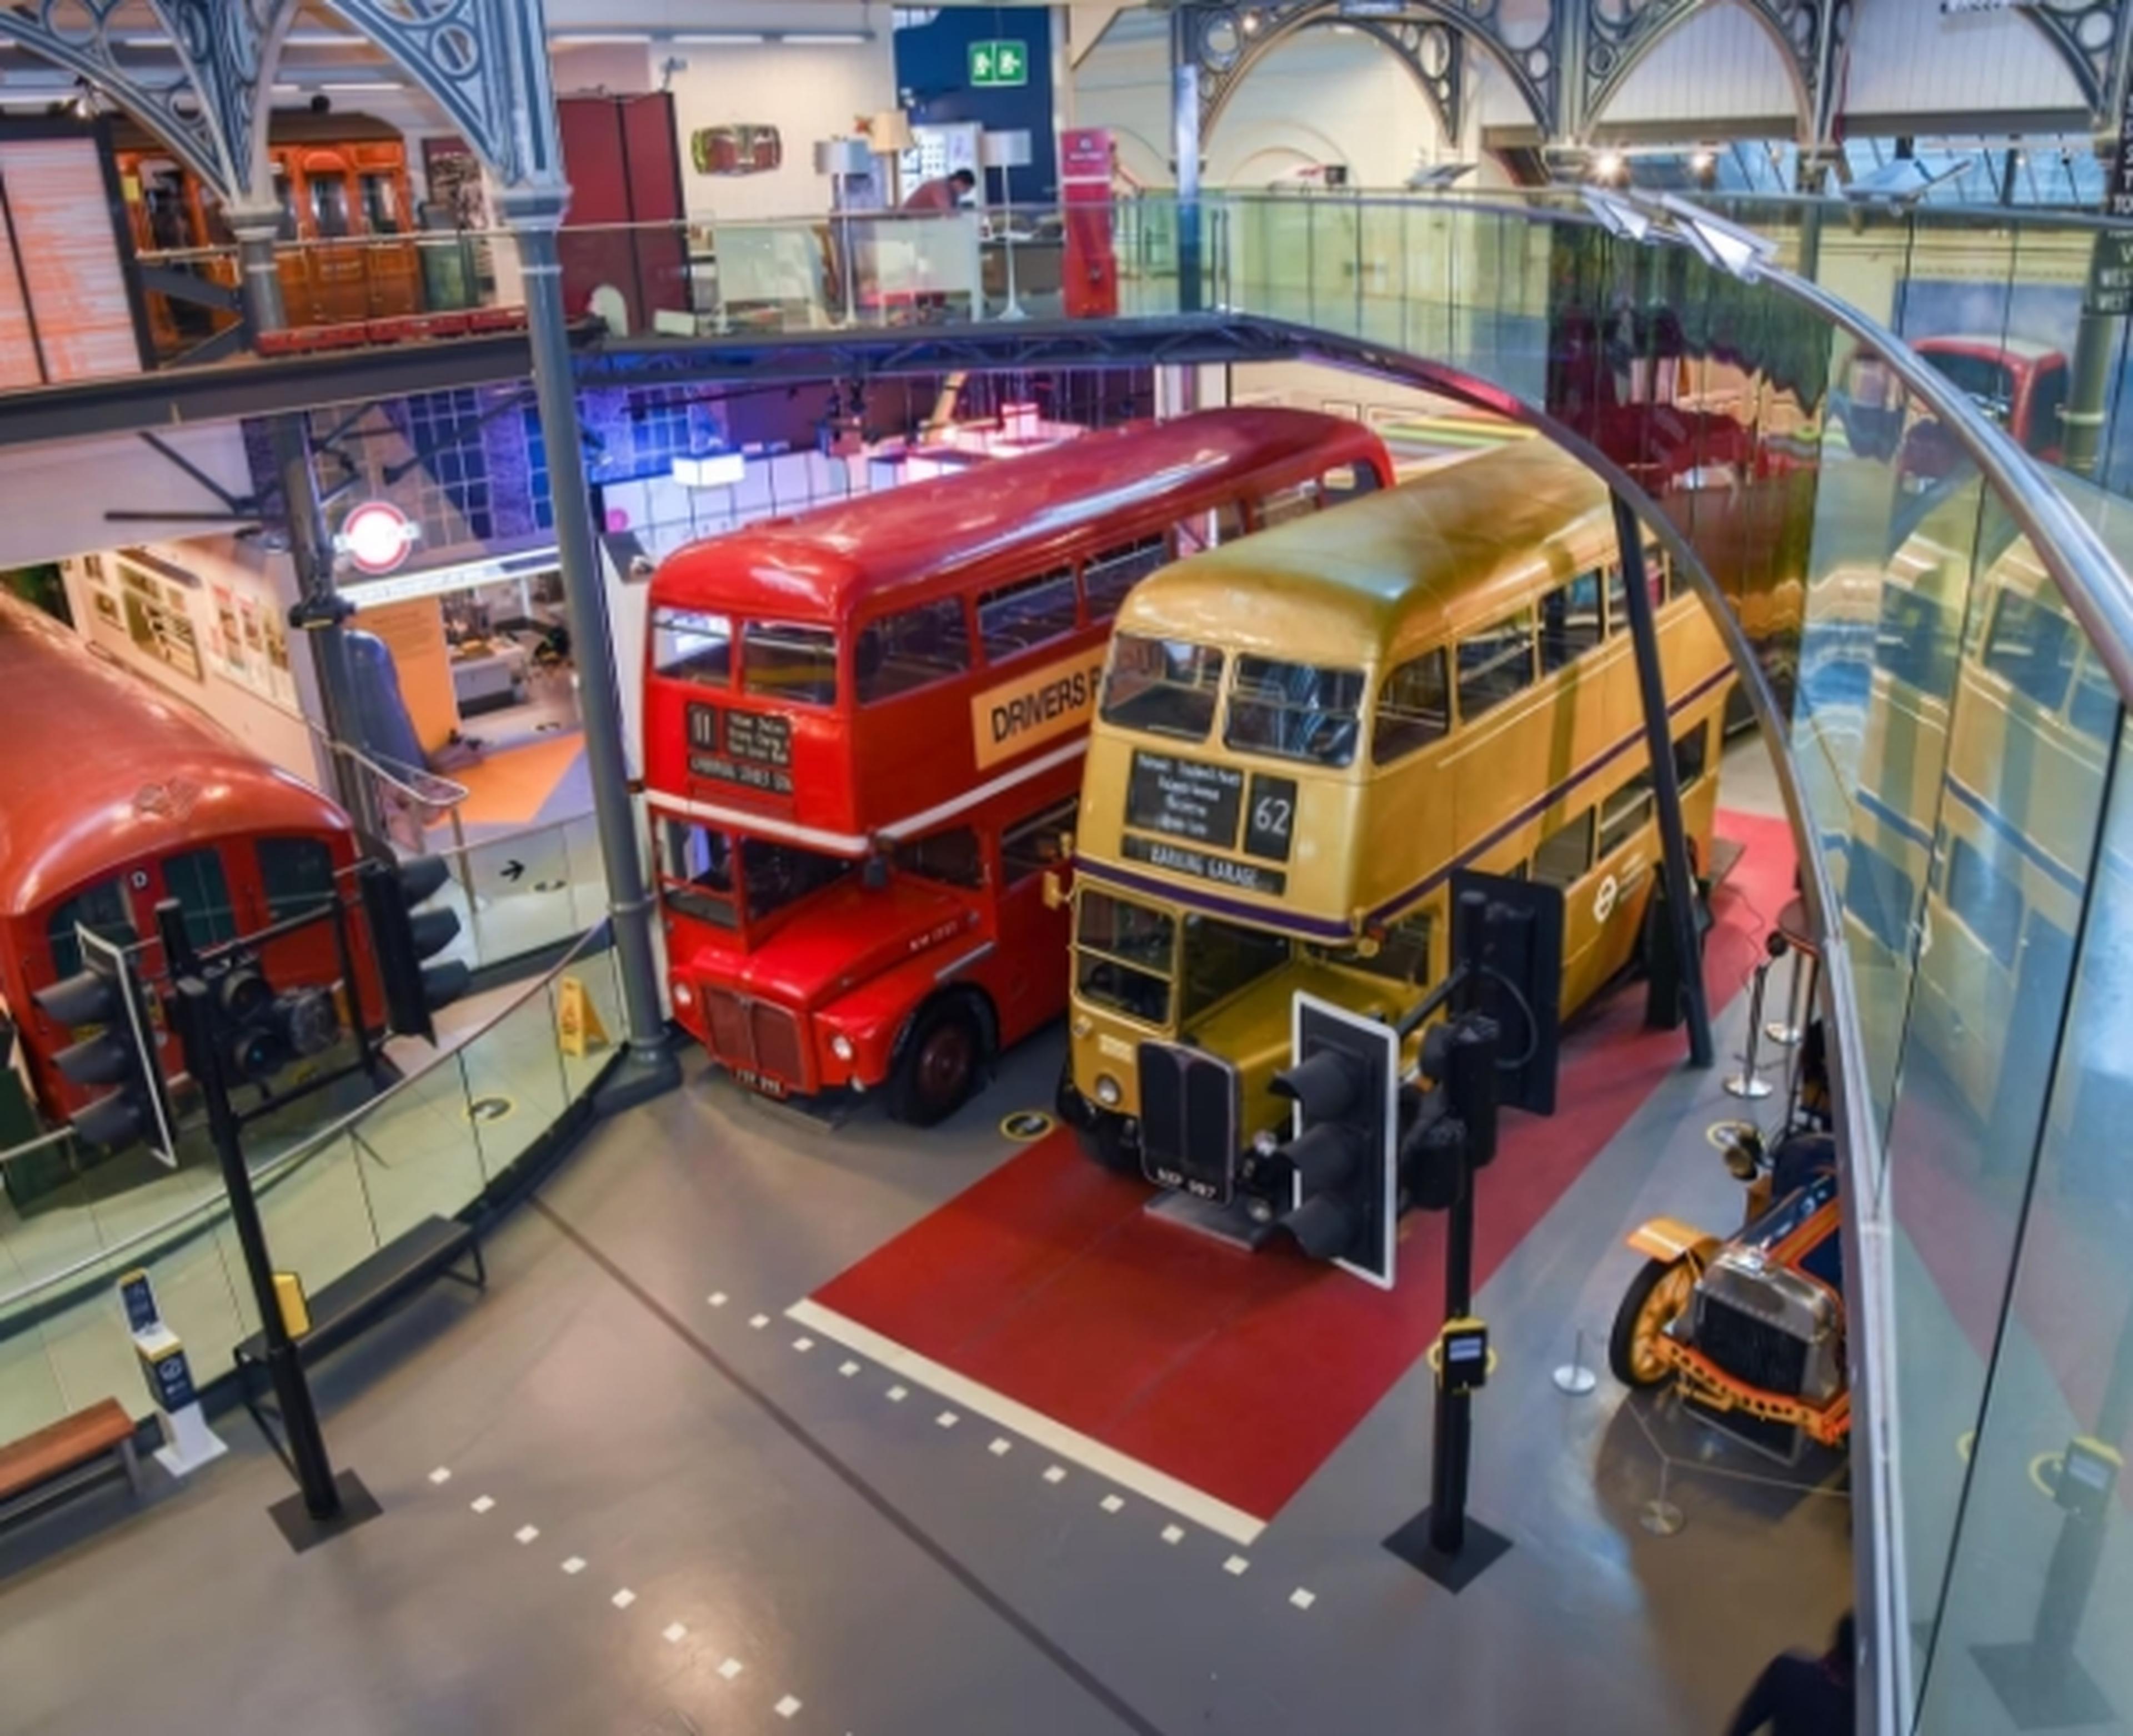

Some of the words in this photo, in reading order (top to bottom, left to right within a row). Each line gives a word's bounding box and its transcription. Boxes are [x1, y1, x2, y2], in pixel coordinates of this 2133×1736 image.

[992, 673, 1086, 744] DRIVERS
[1254, 796, 1291, 836] 62
[131, 870, 148, 889] D
[1207, 858, 1259, 887] GARAGE
